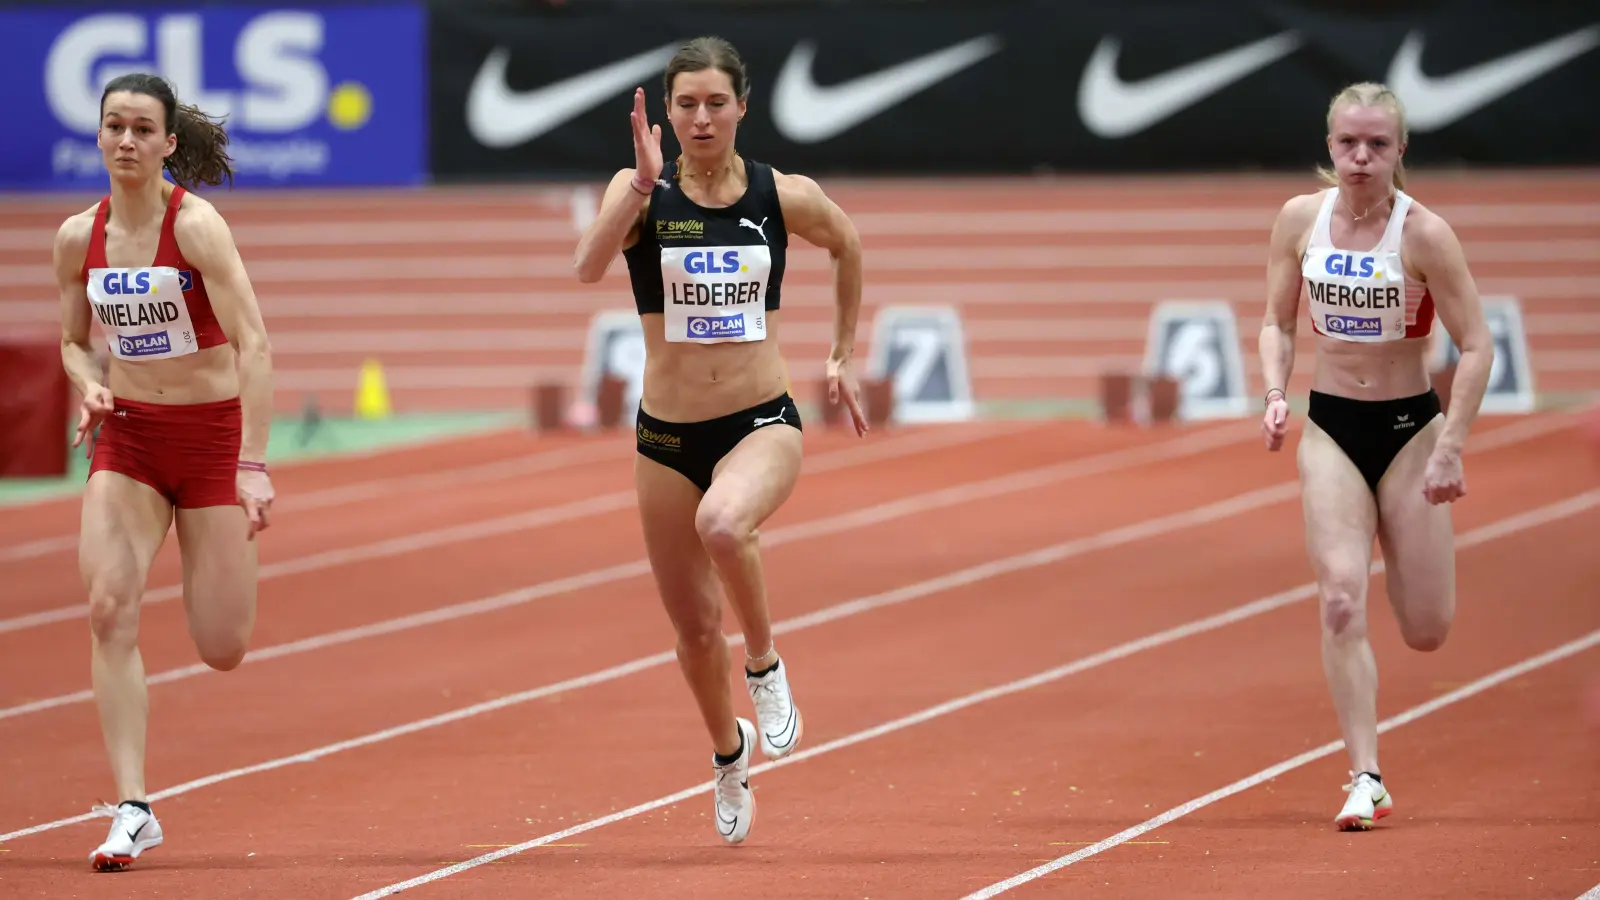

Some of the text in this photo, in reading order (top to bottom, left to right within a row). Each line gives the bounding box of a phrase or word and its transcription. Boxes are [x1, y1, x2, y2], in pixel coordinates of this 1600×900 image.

[671, 281, 760, 306] LEDERER
[1308, 280, 1400, 309] MERCIER
[95, 301, 179, 327] WIELAND
[711, 318, 743, 331] PLAN
[1346, 319, 1379, 329] PLAN
[135, 335, 168, 349] PLAN
[182, 330, 192, 344] 207
[882, 330, 937, 401] 7
[1165, 323, 1216, 396] 6
[1393, 421, 1416, 430] erima
